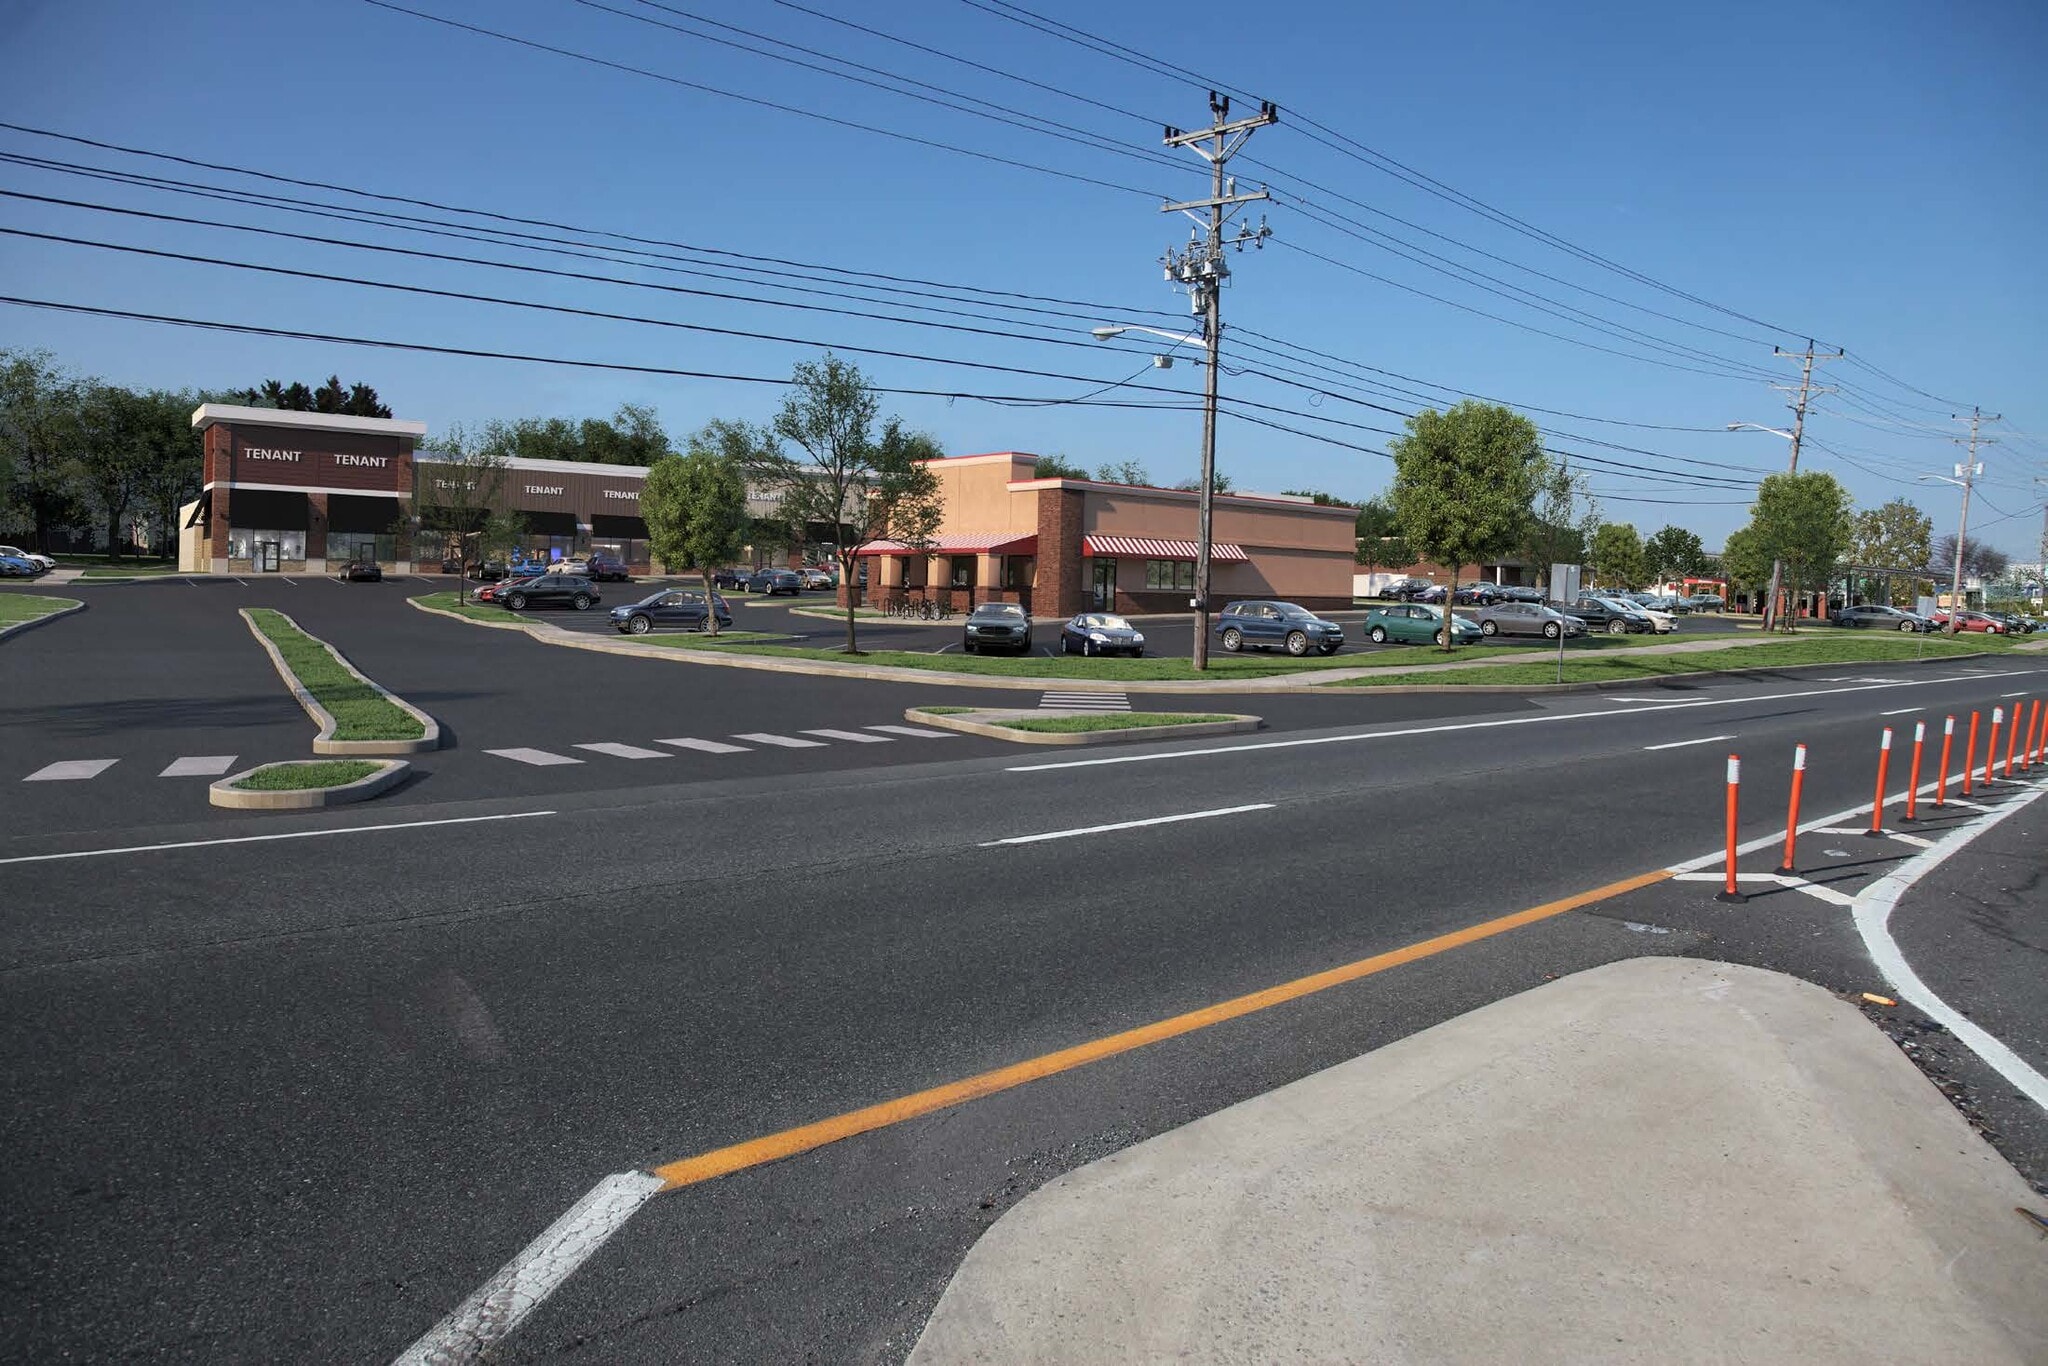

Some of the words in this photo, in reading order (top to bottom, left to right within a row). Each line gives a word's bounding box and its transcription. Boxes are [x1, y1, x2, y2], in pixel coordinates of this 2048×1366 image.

[244, 448, 301, 462] TENANT
[334, 454, 387, 467] TENANT
[525, 485, 563, 495] TENANT
[603, 490, 640, 500] TENANT
